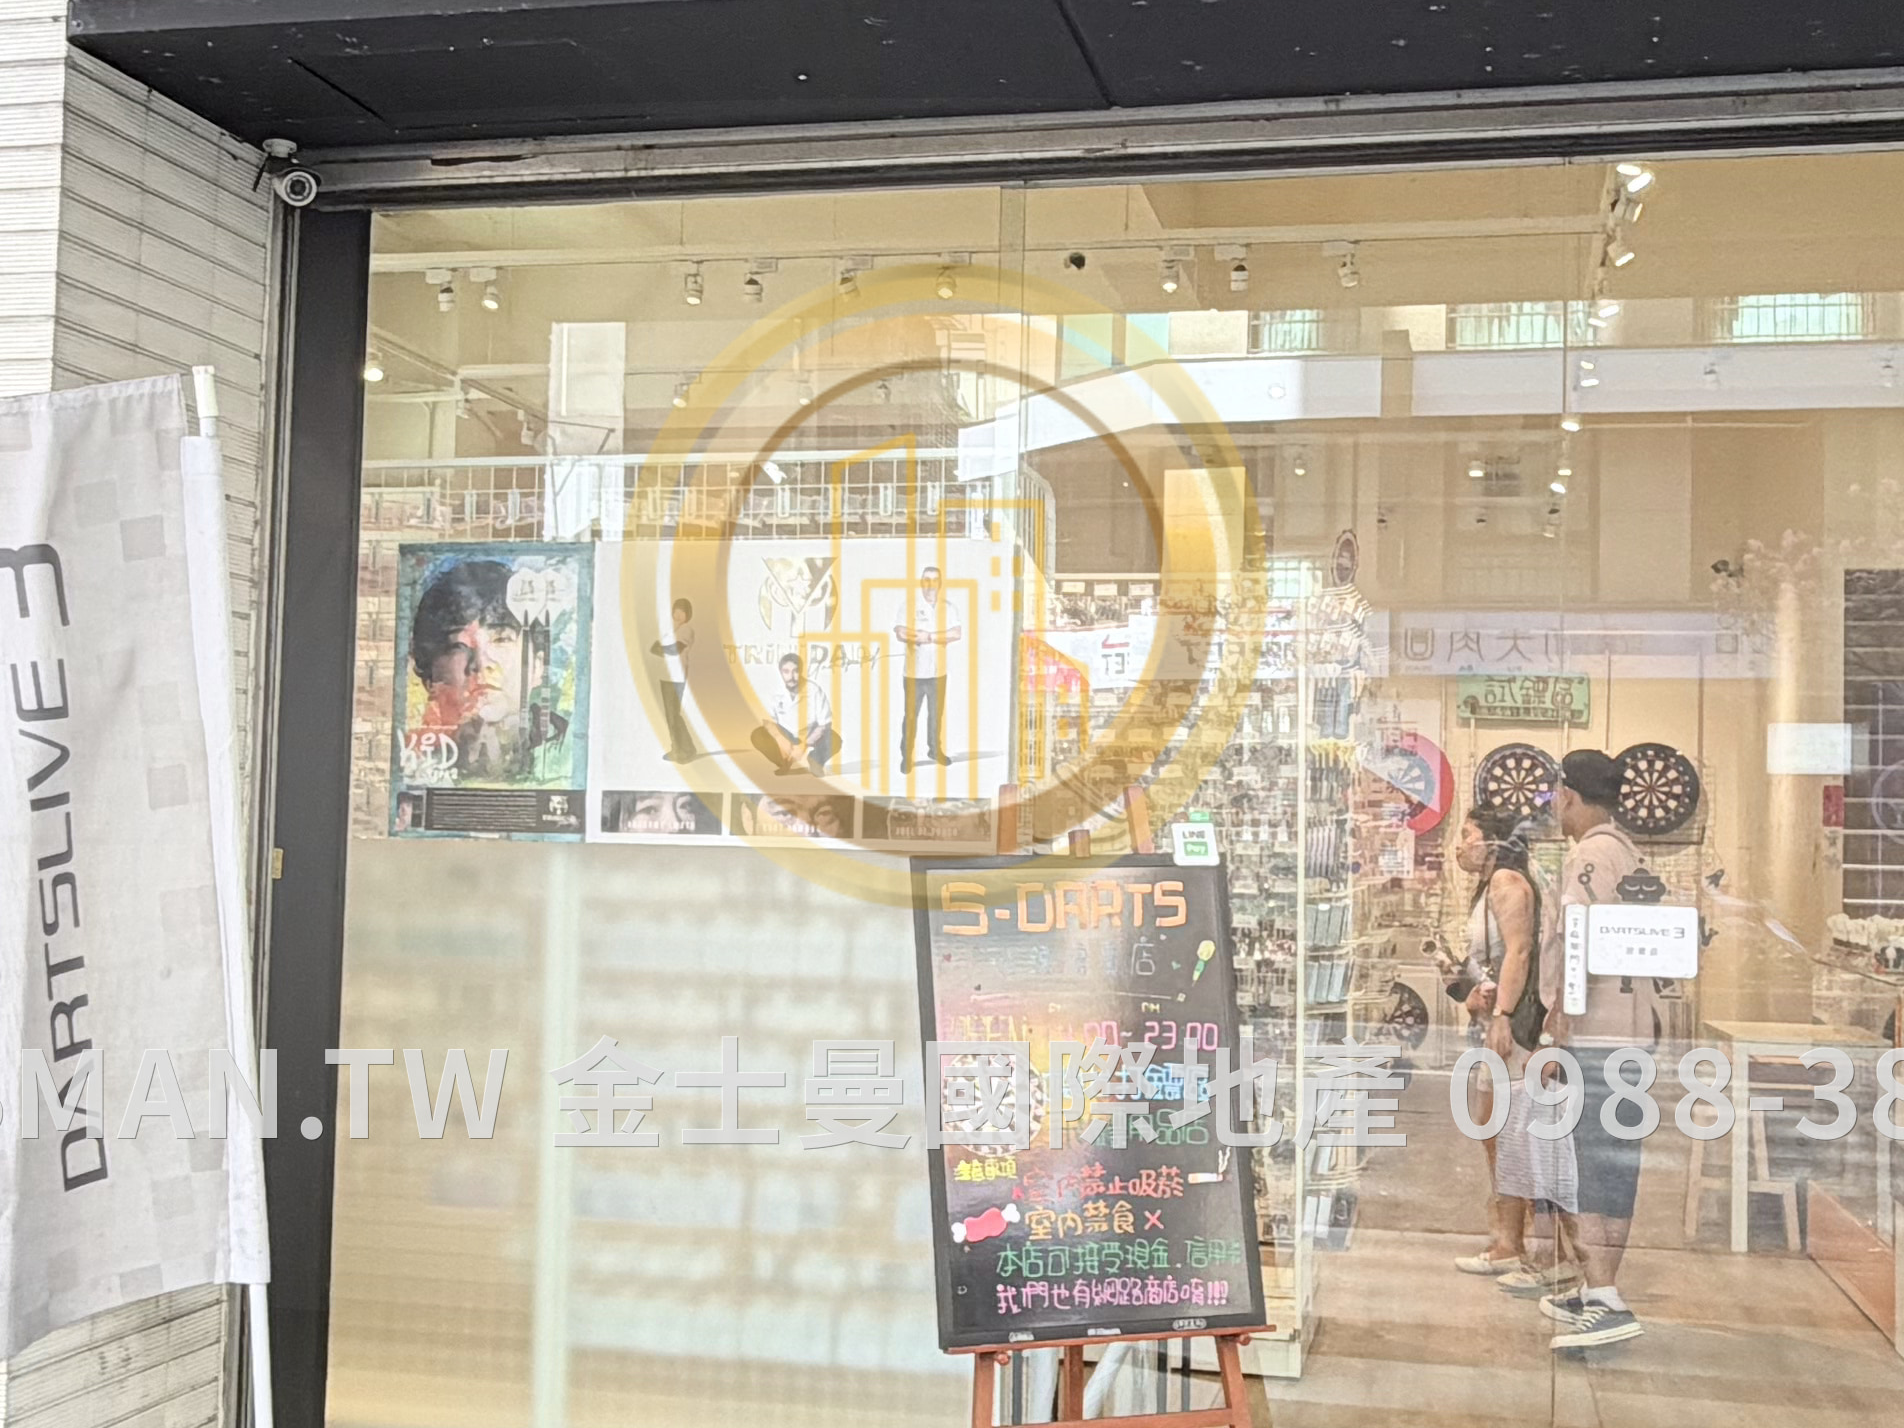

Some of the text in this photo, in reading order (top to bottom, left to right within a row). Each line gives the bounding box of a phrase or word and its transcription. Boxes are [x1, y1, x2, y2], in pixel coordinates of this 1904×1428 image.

[10, 656, 109, 1192] DARTSLIVE
[941, 880, 1187, 936] S-DARTS
[1599, 925, 1685, 939] DARTSLIVE 3
